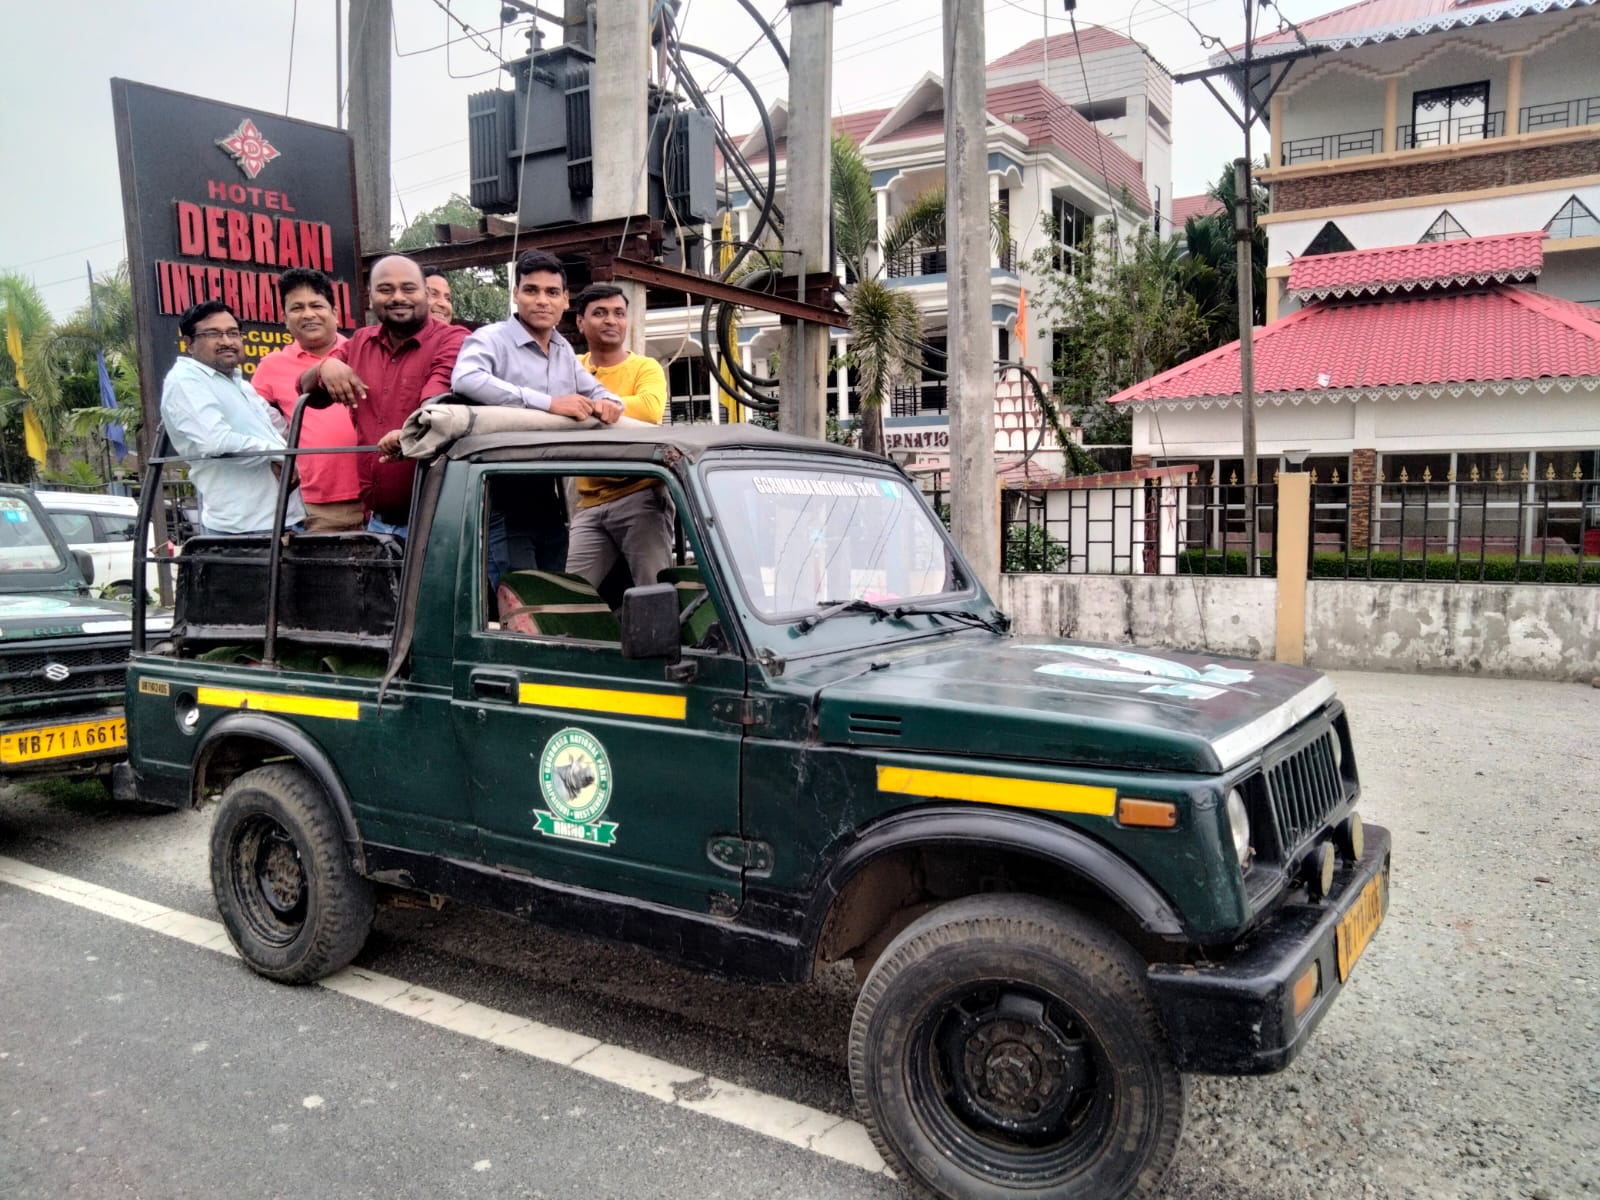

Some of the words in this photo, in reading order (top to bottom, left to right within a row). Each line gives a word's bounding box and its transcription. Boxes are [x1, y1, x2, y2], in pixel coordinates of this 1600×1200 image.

[207, 179, 296, 212] HOTEL
[176, 200, 334, 272] DEBRANI
[156, 260, 356, 330] INTERNATL
[885, 431, 949, 449] ERNATIO
